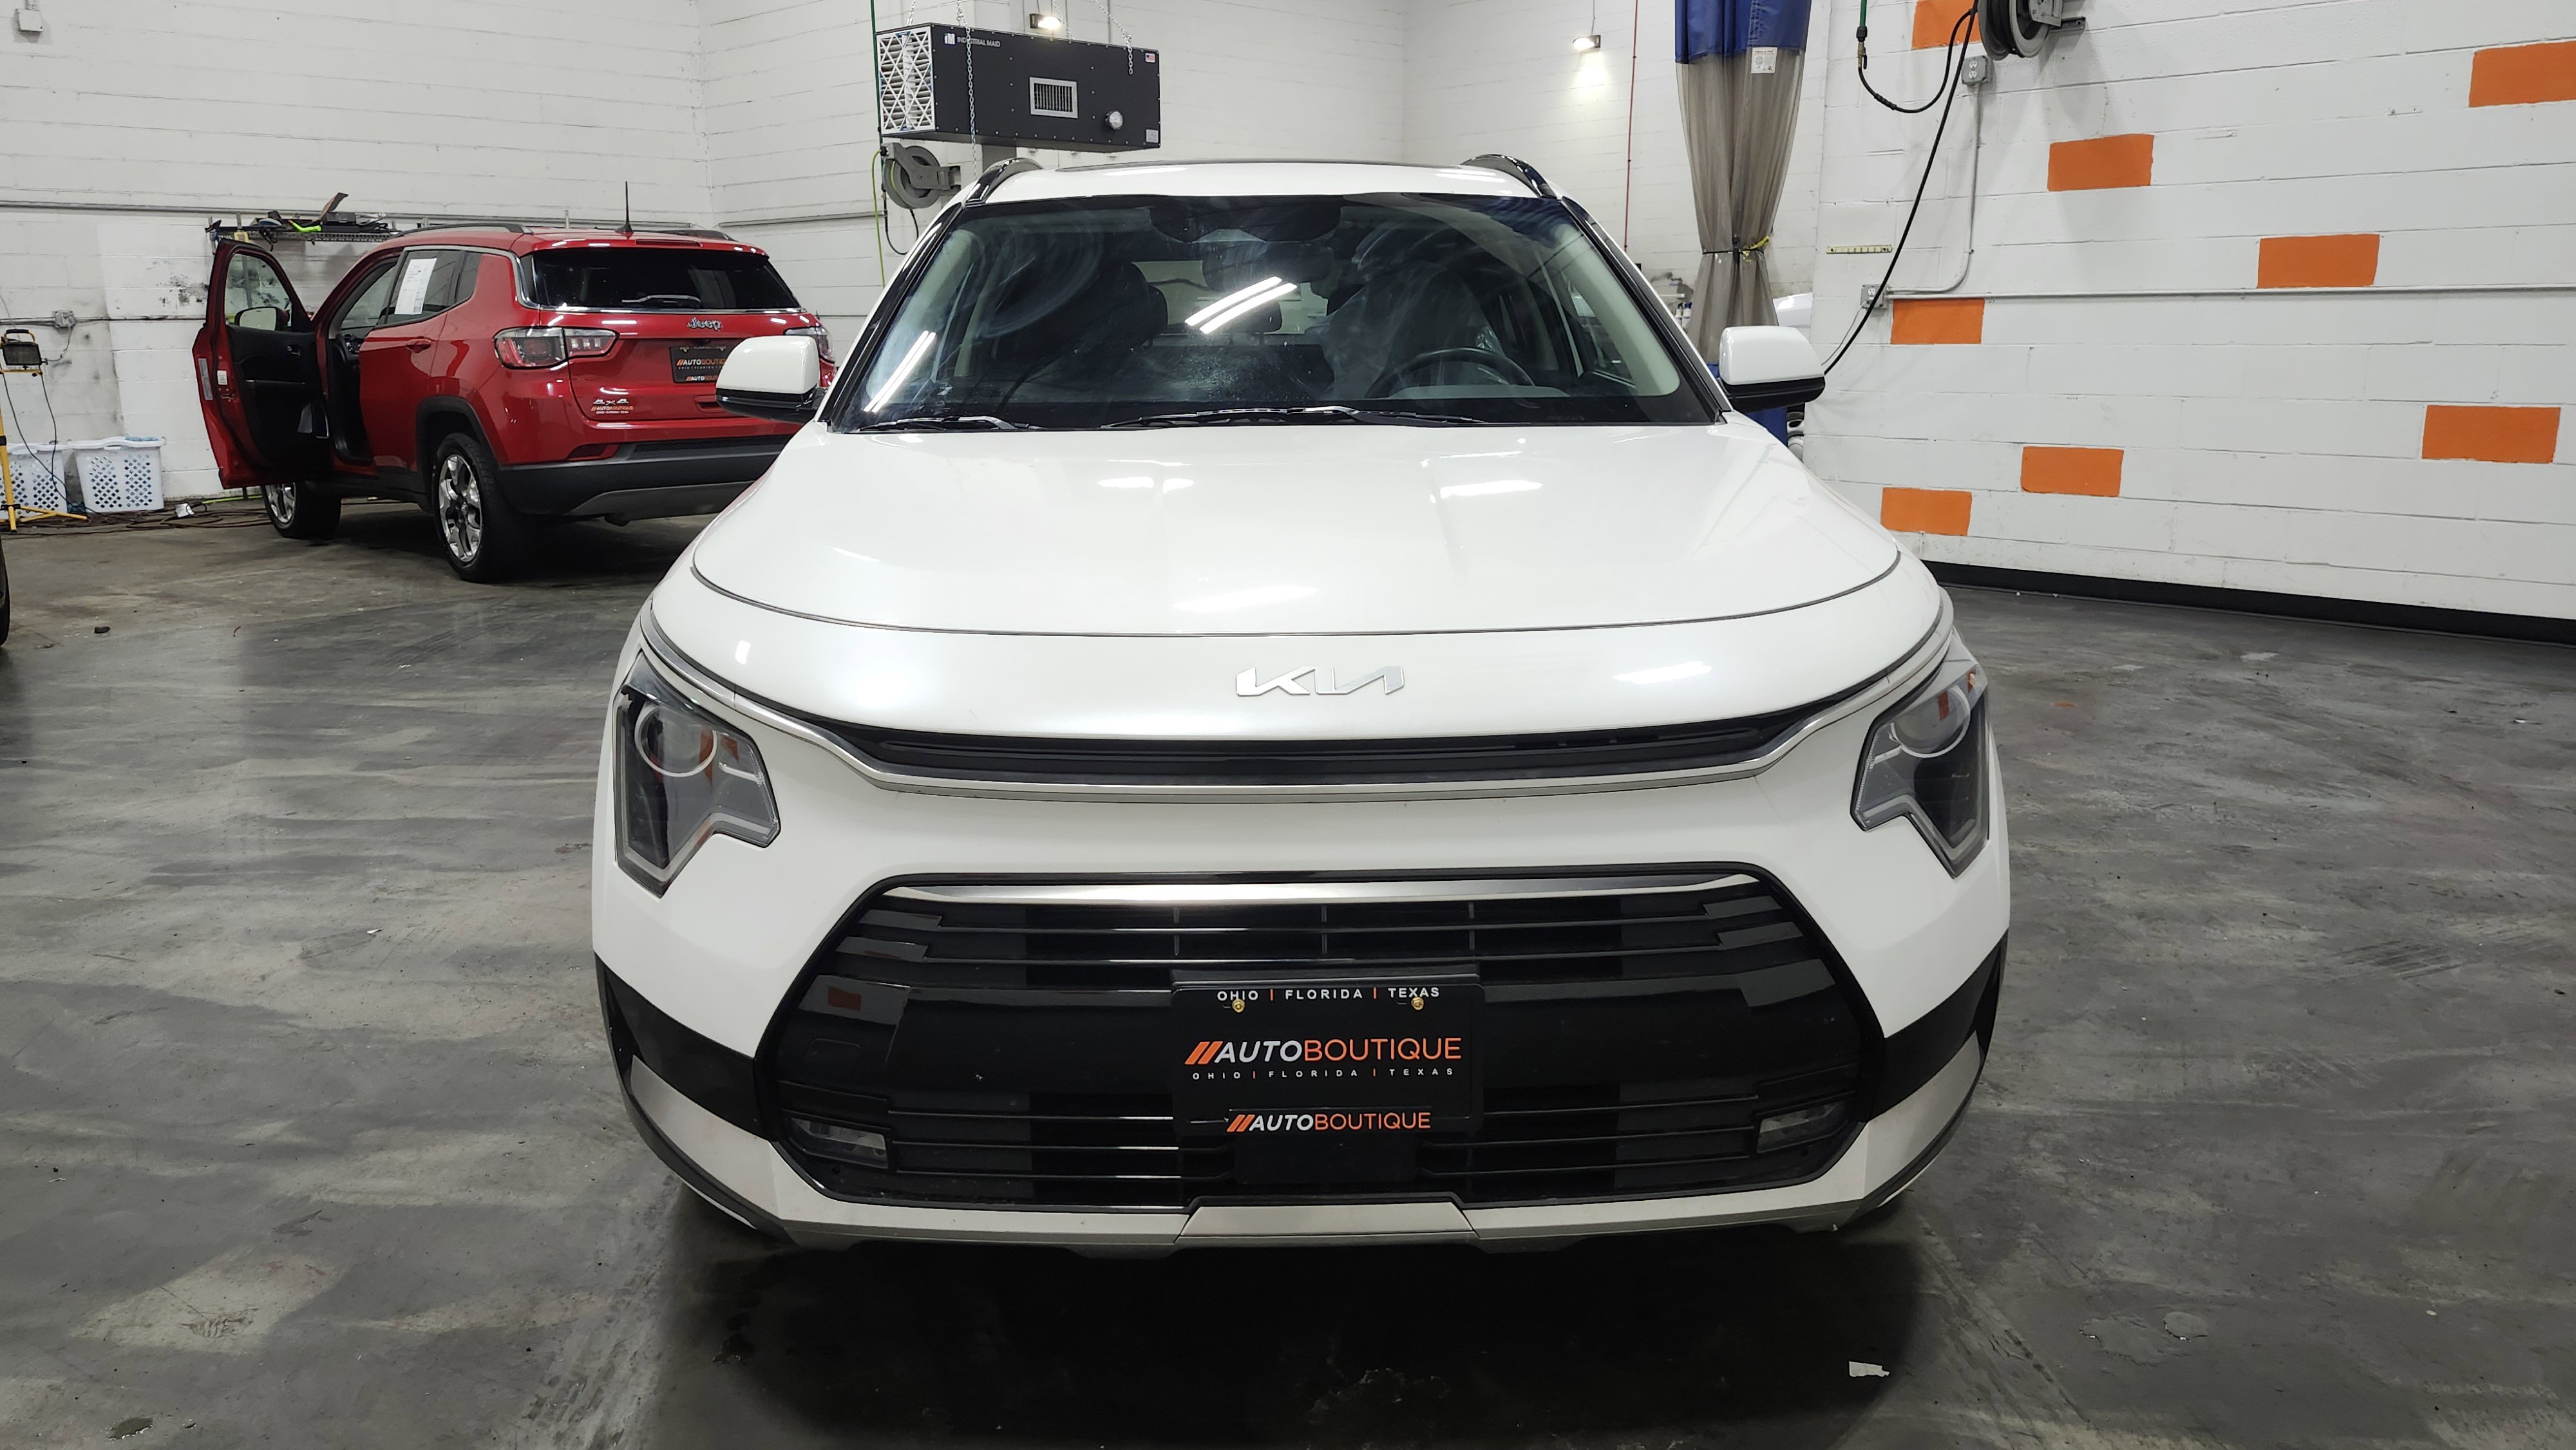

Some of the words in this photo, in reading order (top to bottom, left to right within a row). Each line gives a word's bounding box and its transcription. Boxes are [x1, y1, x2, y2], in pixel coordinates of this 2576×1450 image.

[957, 36, 986, 46] INDSTRIAL
[687, 317, 721, 330] Jeep
[1236, 666, 1405, 696] KIA
[1217, 990, 1258, 1001] OHIO
[1285, 988, 1363, 1000] FLORIDA
[1388, 986, 1439, 998] TEXAS
[1214, 1037, 1463, 1064] AUTOBOUTIQUE
[1192, 1071, 1242, 1080] OHIO
[1269, 1069, 1358, 1078] FLORIDA
[1389, 1068, 1454, 1077] TEXAS
[1248, 1112, 1432, 1133] AUTOBOUTIQUE
